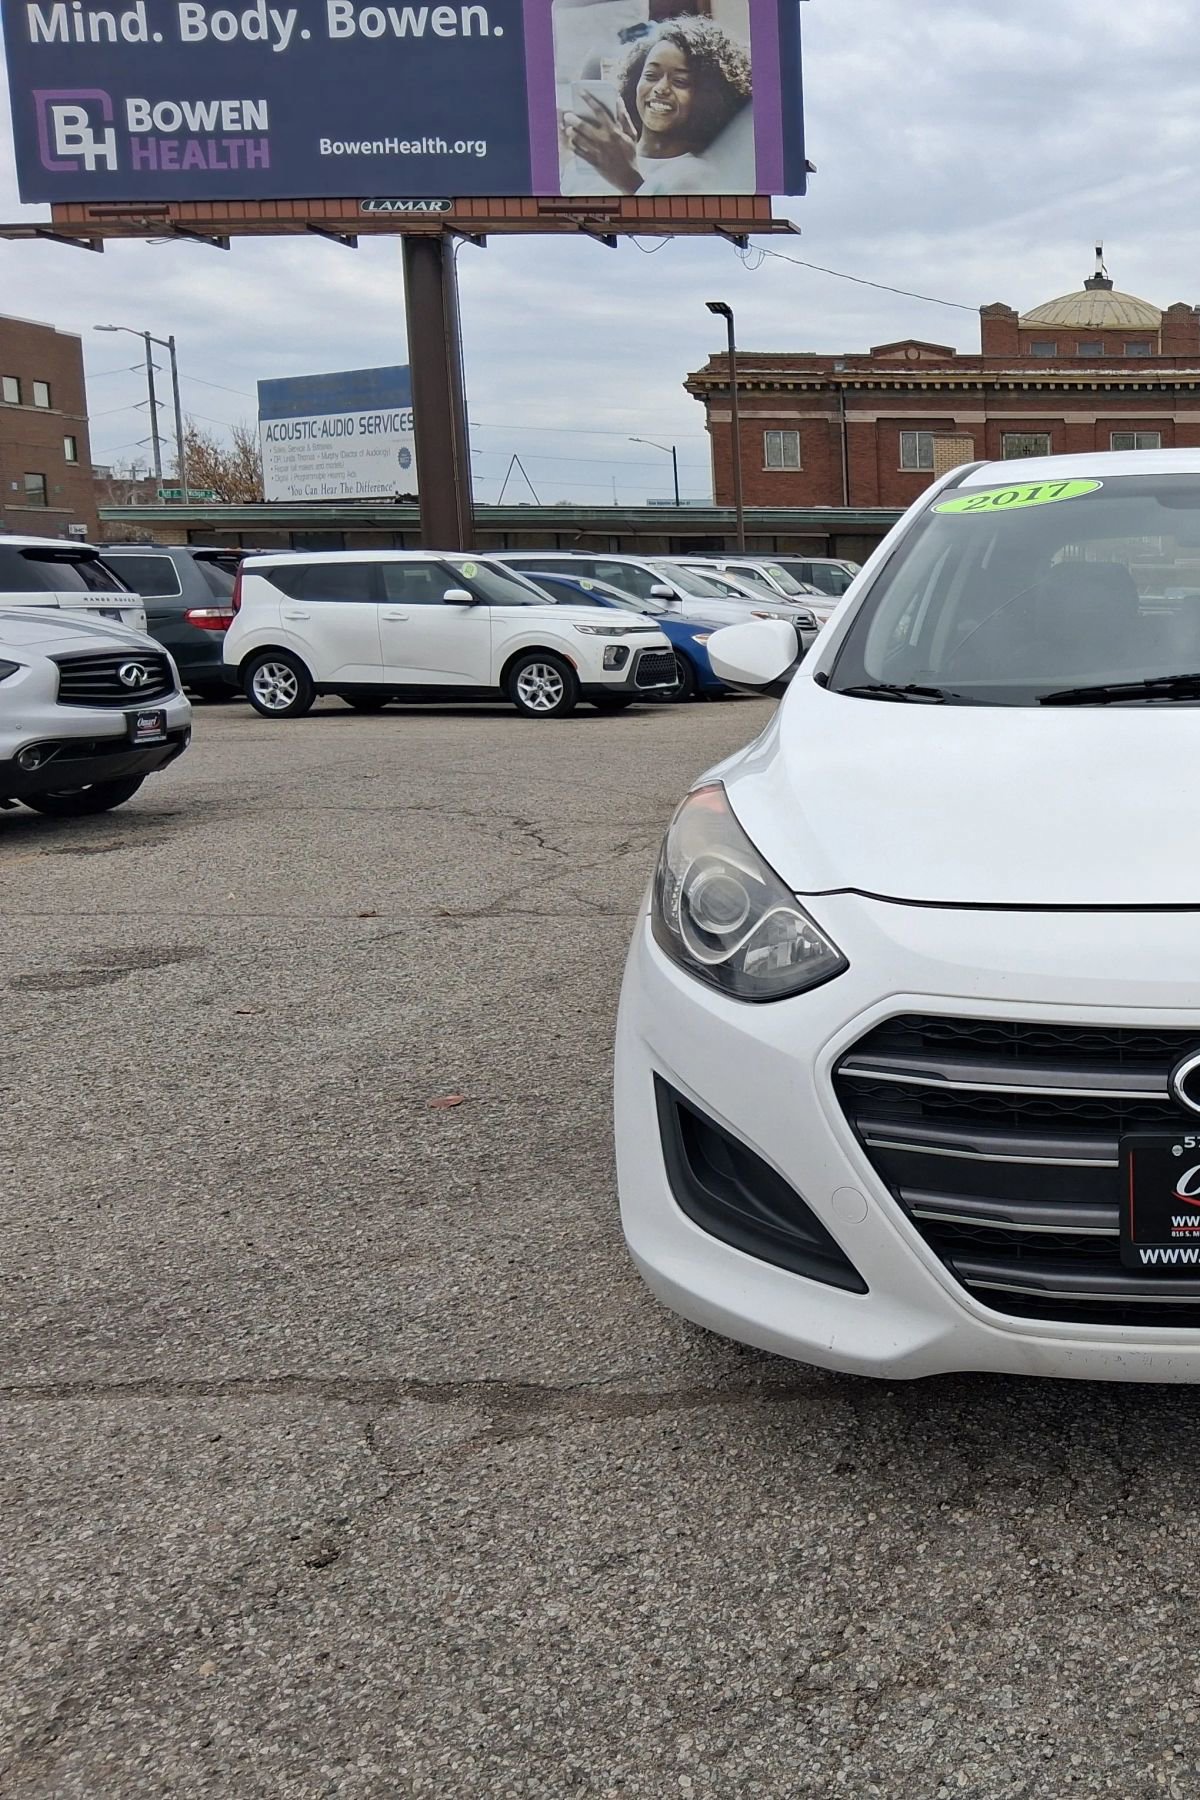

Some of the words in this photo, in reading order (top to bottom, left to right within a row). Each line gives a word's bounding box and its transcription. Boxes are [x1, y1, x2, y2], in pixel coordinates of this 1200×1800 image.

[27, 1, 163, 43] Mind.
[178, 0, 311, 52] Body.
[327, 0, 504, 38] Bowen.
[125, 98, 268, 132] BOWEN
[129, 137, 270, 170] HEALTH
[319, 137, 487, 157] BowenHealth.org
[368, 201, 443, 211] LAMAR
[359, 412, 414, 435] SERVICES
[304, 484, 318, 496] Can
[320, 483, 337, 495] Hear
[340, 482, 354, 494] The
[962, 482, 1071, 511] 2017
